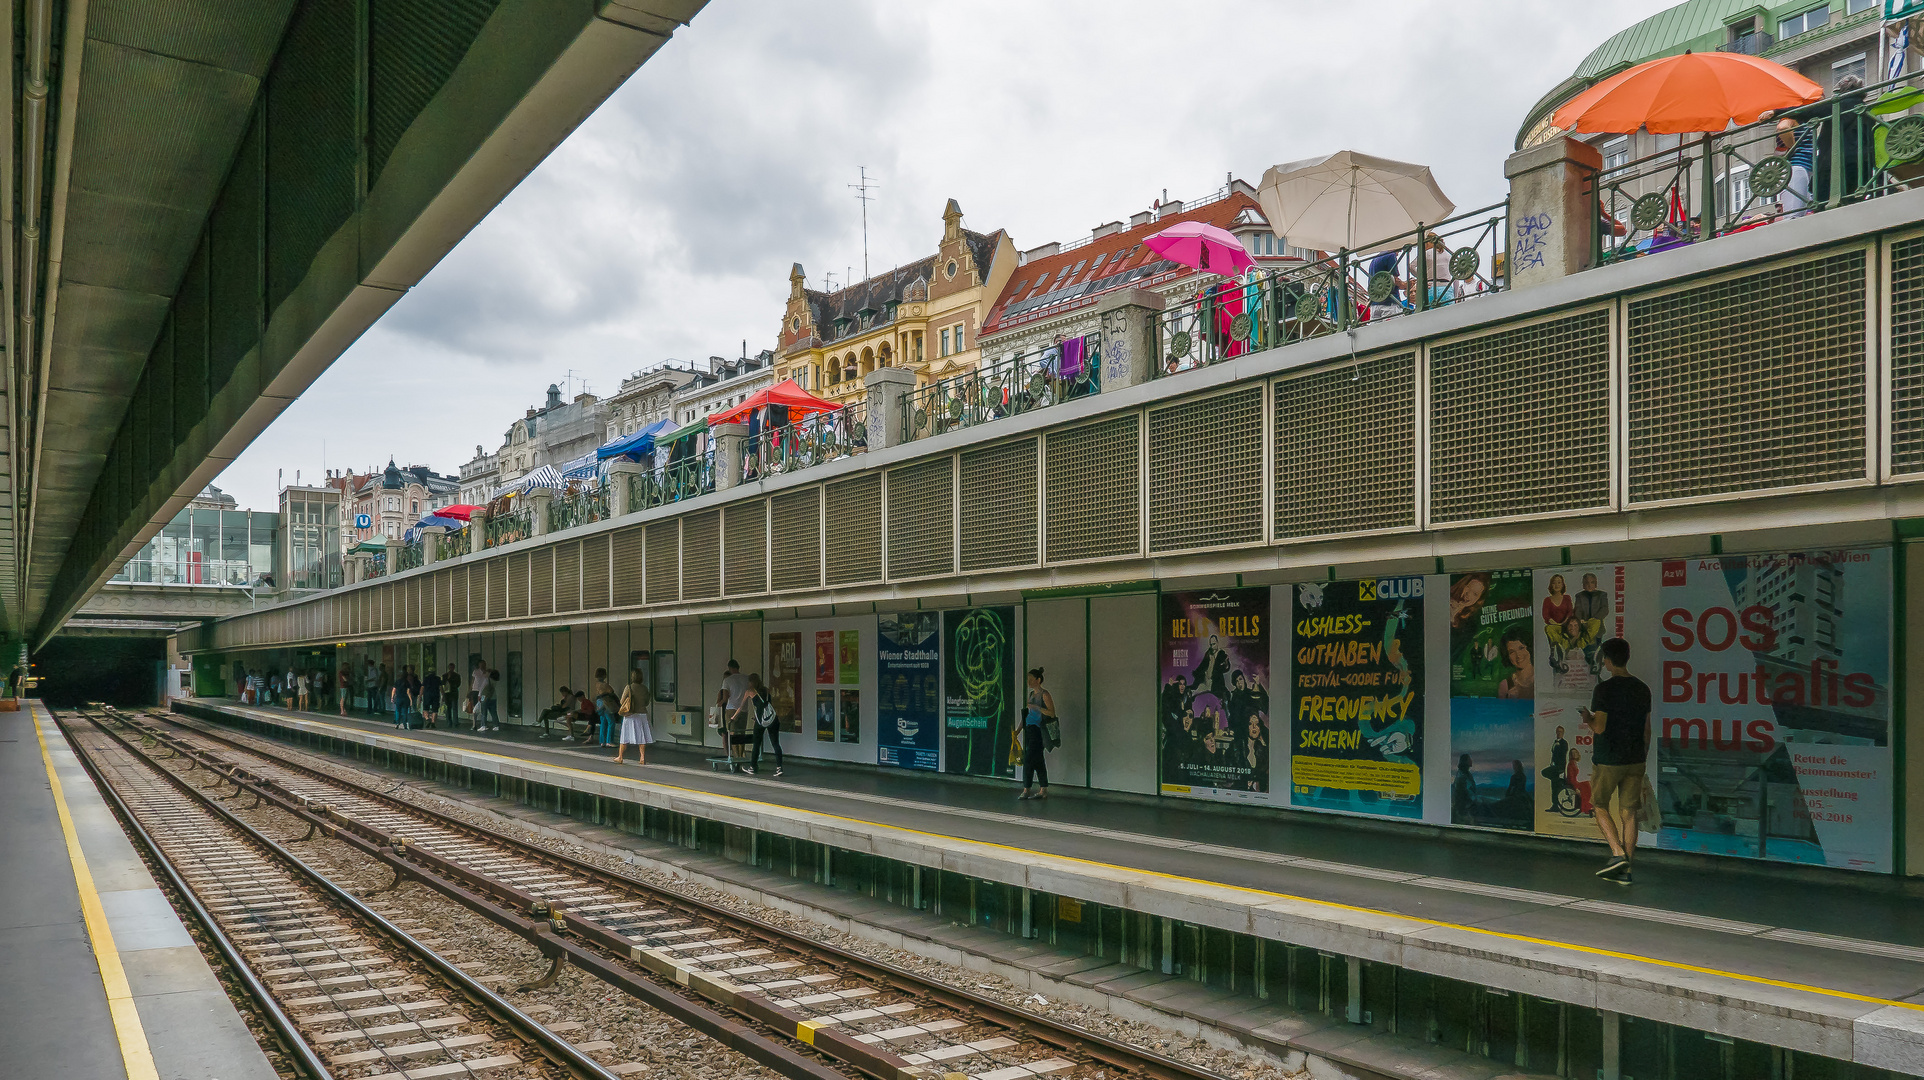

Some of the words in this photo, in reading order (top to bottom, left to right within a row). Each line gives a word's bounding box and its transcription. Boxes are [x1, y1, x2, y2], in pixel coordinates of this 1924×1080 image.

[360, 516, 368, 526] U
[1698, 552, 1833, 572] Architekturzentrum
[1834, 552, 1870, 564] Wien
[1377, 579, 1424, 598] CLUB
[1614, 566, 1625, 613] ELTERN
[1480, 613, 1498, 625] GUTE
[1498, 606, 1532, 622] FREUNDIN
[1219, 615, 1260, 637] BELLS
[1297, 614, 1371, 638] CASHLESS-
[1661, 605, 1776, 652] SOS
[780, 642, 796, 662] ABO
[880, 650, 903, 660] Wiener
[904, 650, 938, 660] Stadthalle
[1298, 640, 1382, 667] GUTHABEN
[1298, 670, 1381, 688] FESTIVAL-GOODIE
[1662, 660, 1876, 708] Brutalis
[1298, 691, 1414, 722] FREQUENCY
[948, 718, 987, 729] AugenSchein
[1300, 729, 1361, 750] SICHERN!
[1662, 718, 1775, 753] mus
[1794, 754, 1826, 766] Rettet
[1830, 756, 1847, 765] die
[1794, 766, 1876, 780] Betonmonster!
[1794, 788, 1858, 802] Ausstellung
